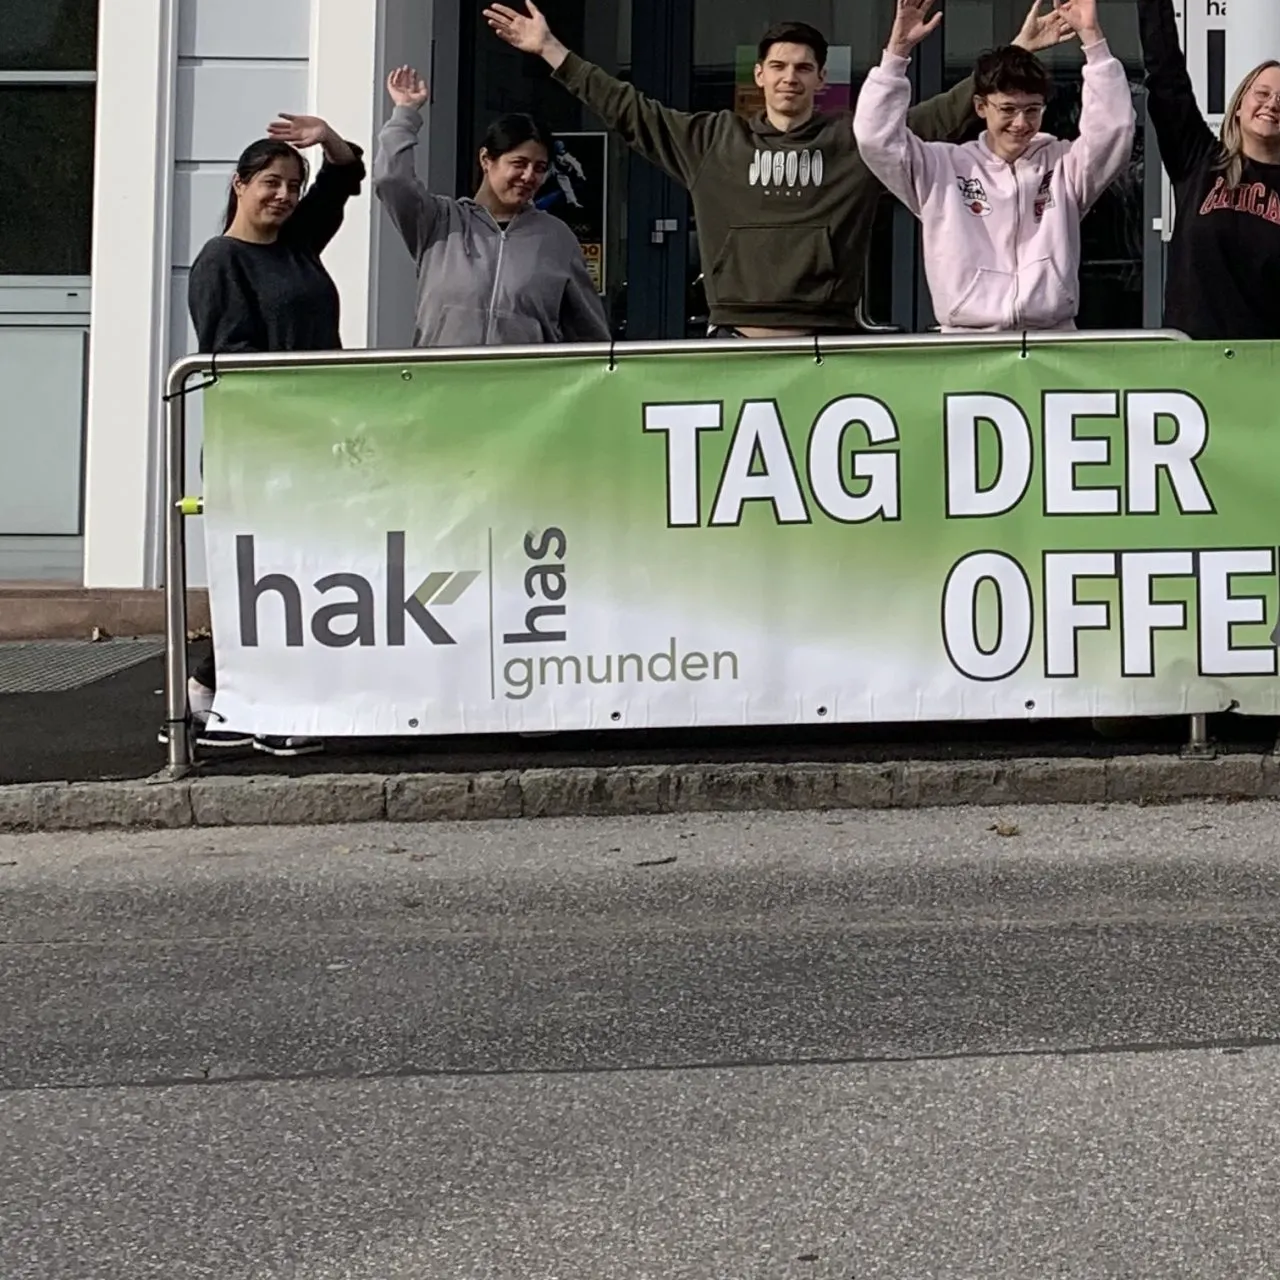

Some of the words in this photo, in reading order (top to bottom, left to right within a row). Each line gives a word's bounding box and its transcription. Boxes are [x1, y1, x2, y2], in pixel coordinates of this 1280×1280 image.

[641, 393, 900, 528] TAG
[943, 388, 1217, 521] DER
[235, 530, 470, 648] hak
[502, 526, 567, 645] has
[502, 637, 740, 701] gmunden
